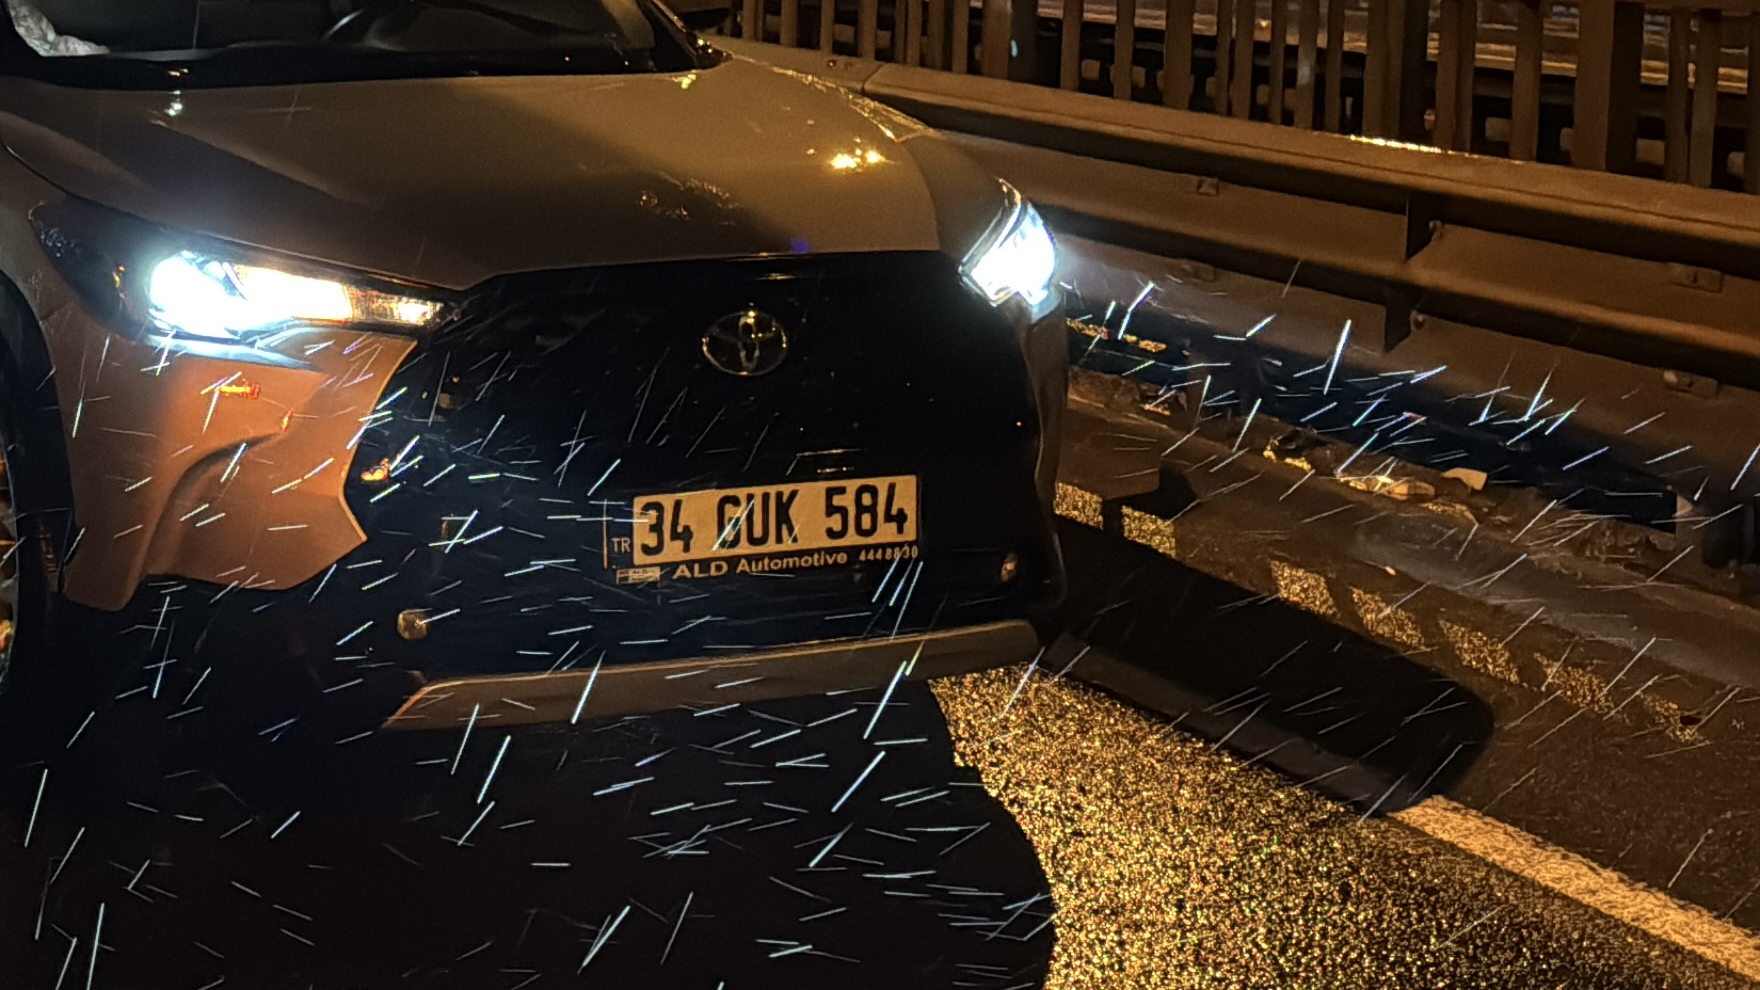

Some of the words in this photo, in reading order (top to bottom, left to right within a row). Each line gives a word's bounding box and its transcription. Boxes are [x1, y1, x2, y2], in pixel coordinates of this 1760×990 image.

[641, 499, 693, 556] 34
[718, 489, 799, 550] GUK
[825, 482, 908, 540] 584
[611, 537, 631, 554] TR
[672, 561, 729, 580] ALD
[736, 551, 848, 573] Automotive
